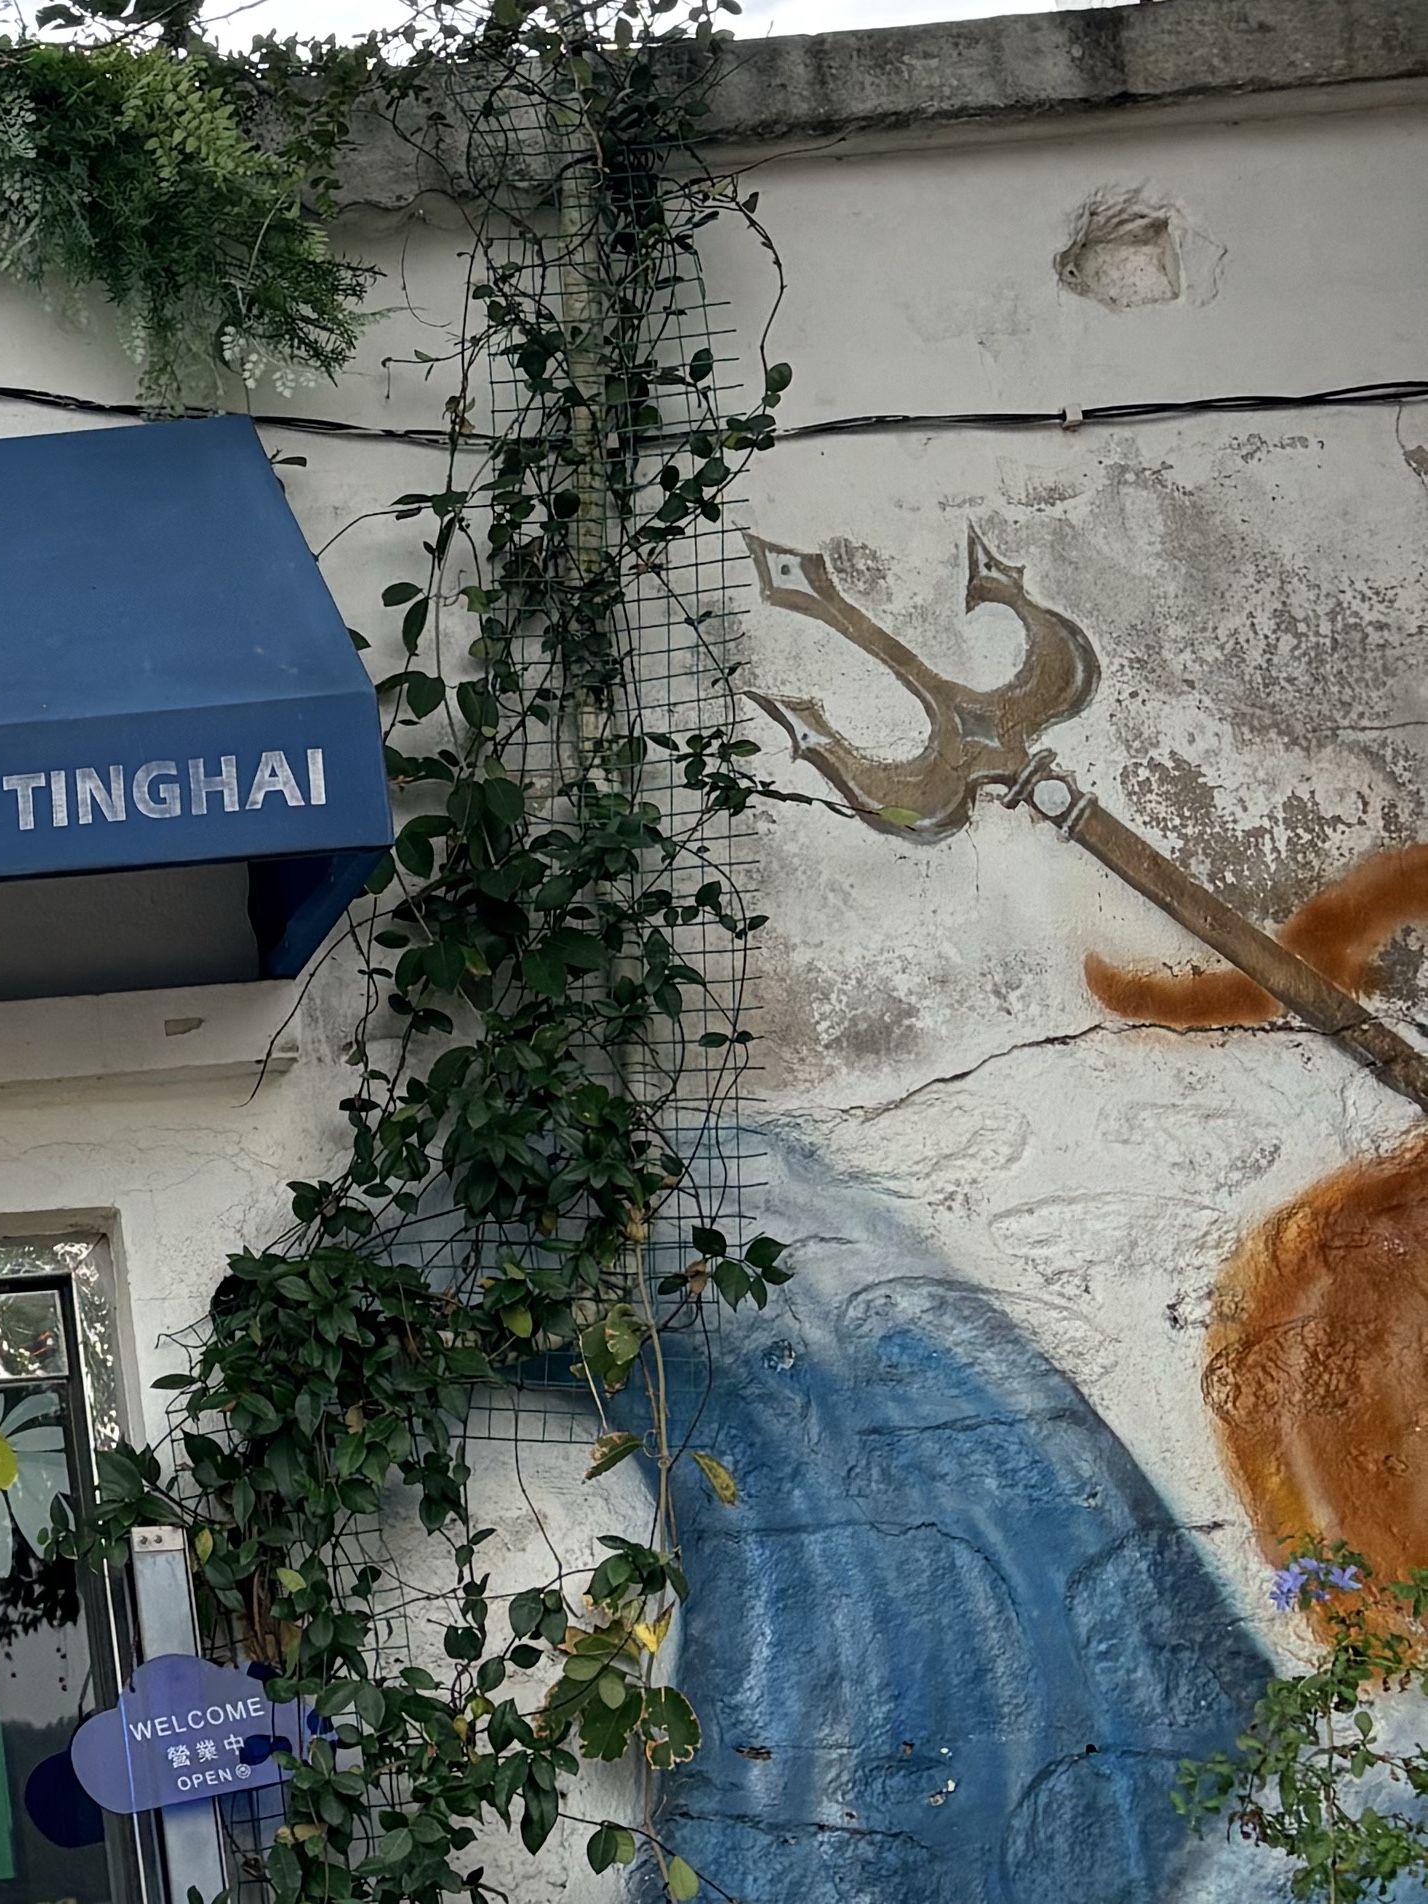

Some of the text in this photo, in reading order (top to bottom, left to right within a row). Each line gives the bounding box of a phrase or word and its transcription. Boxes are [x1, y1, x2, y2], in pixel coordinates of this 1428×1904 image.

[1, 748, 327, 832] TINGHAI
[129, 1696, 266, 1742] WELCOME
[166, 1733, 245, 1769] 營業中
[176, 1768, 233, 1792] OPEN
